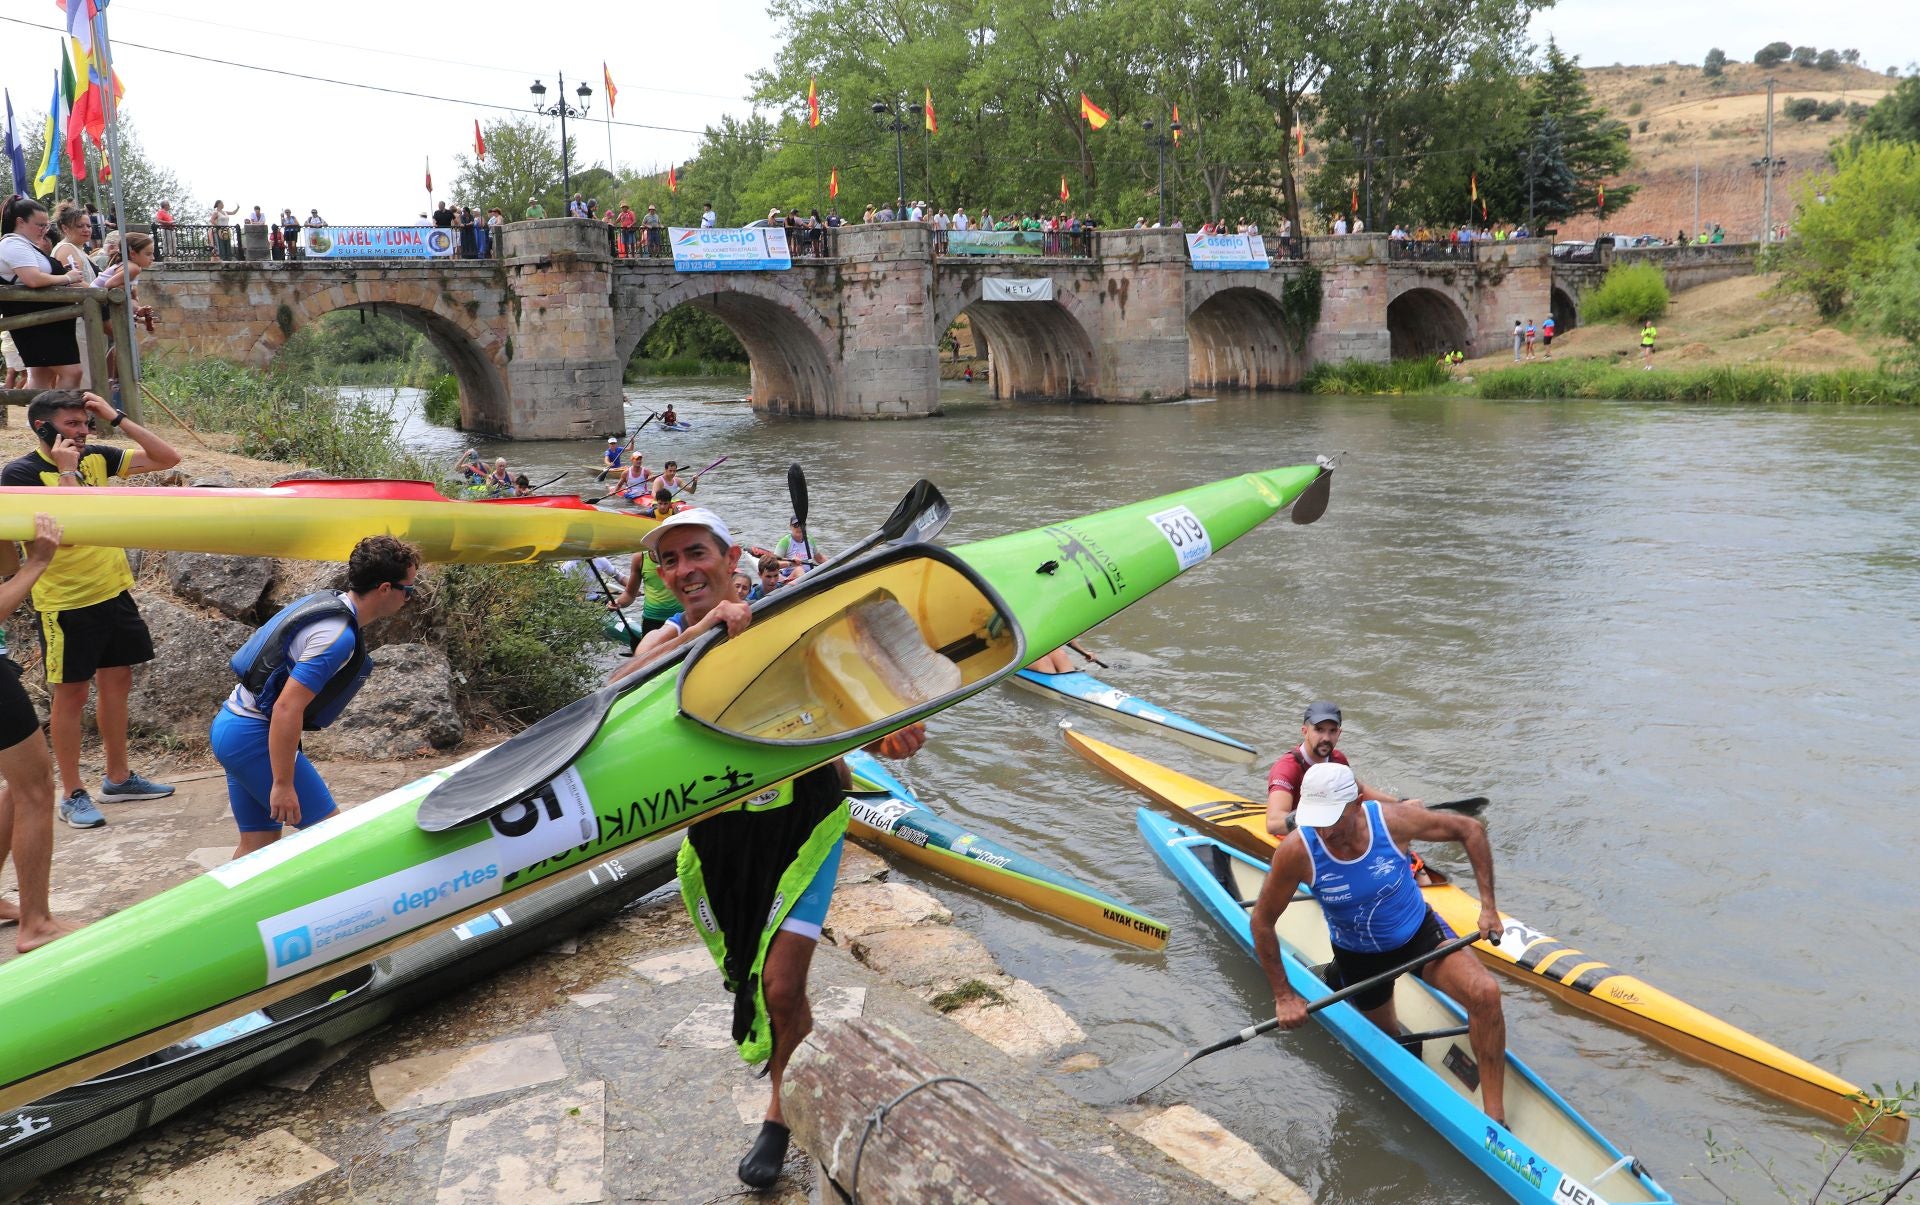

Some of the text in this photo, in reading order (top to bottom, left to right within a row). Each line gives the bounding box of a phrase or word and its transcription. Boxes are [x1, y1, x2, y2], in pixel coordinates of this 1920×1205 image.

[337, 230, 371, 246] AXEL
[385, 230, 422, 246] LUNA
[701, 230, 756, 246] asenjo
[1208, 236, 1244, 249] asenjo
[1005, 285, 1032, 294] META
[1161, 516, 1203, 547] 819
[863, 808, 892, 831] VEGA
[392, 863, 499, 916] deportes
[314, 909, 374, 937] Diputación
[316, 915, 388, 948] DE PALENCIA
[1103, 907, 1168, 941] KAYAK CENTRE
